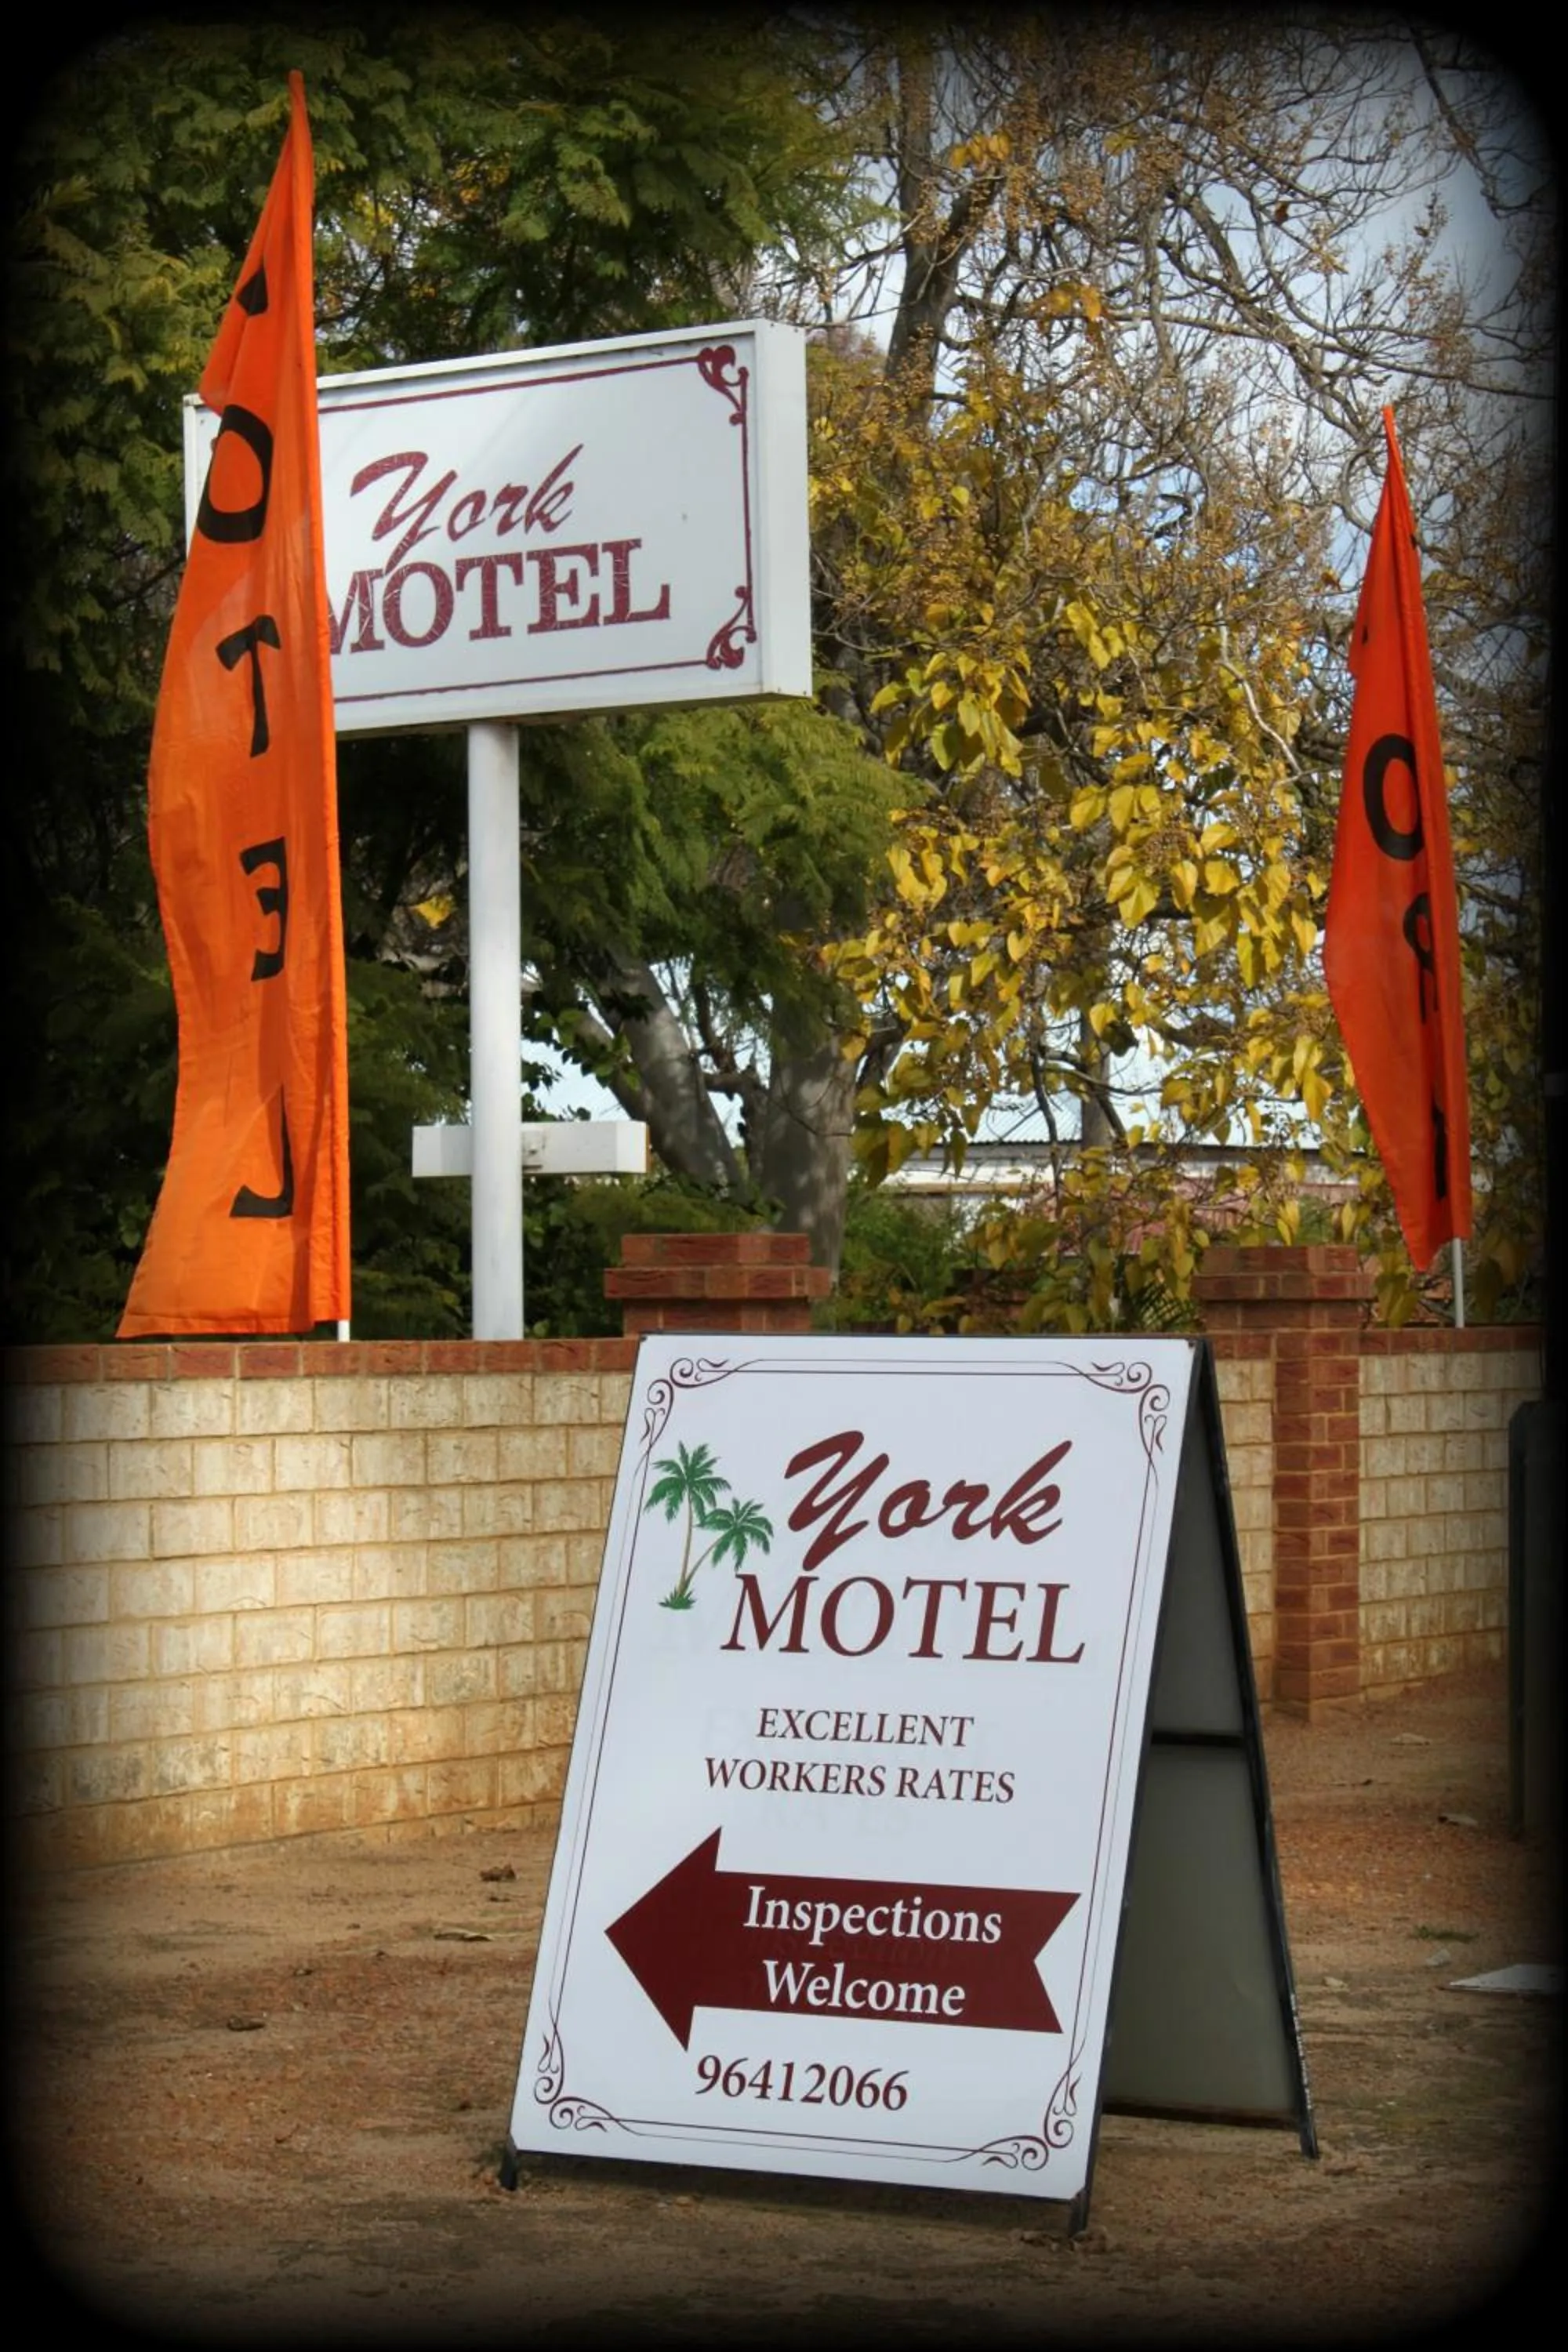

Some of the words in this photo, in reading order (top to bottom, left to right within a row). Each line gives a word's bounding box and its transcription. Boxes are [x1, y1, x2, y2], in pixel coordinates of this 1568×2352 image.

[350, 443, 584, 575] York
[784, 1431, 1073, 1571] York
[720, 1573, 1086, 1664] MOTEL
[756, 1708, 975, 1747] EXCELLENT
[705, 1757, 887, 1796] WORKERS
[896, 1766, 1015, 1804] RATES
[743, 1886, 1003, 1945] Inspections
[763, 1960, 966, 2016] Welcome
[695, 2055, 909, 2111] 96412066
